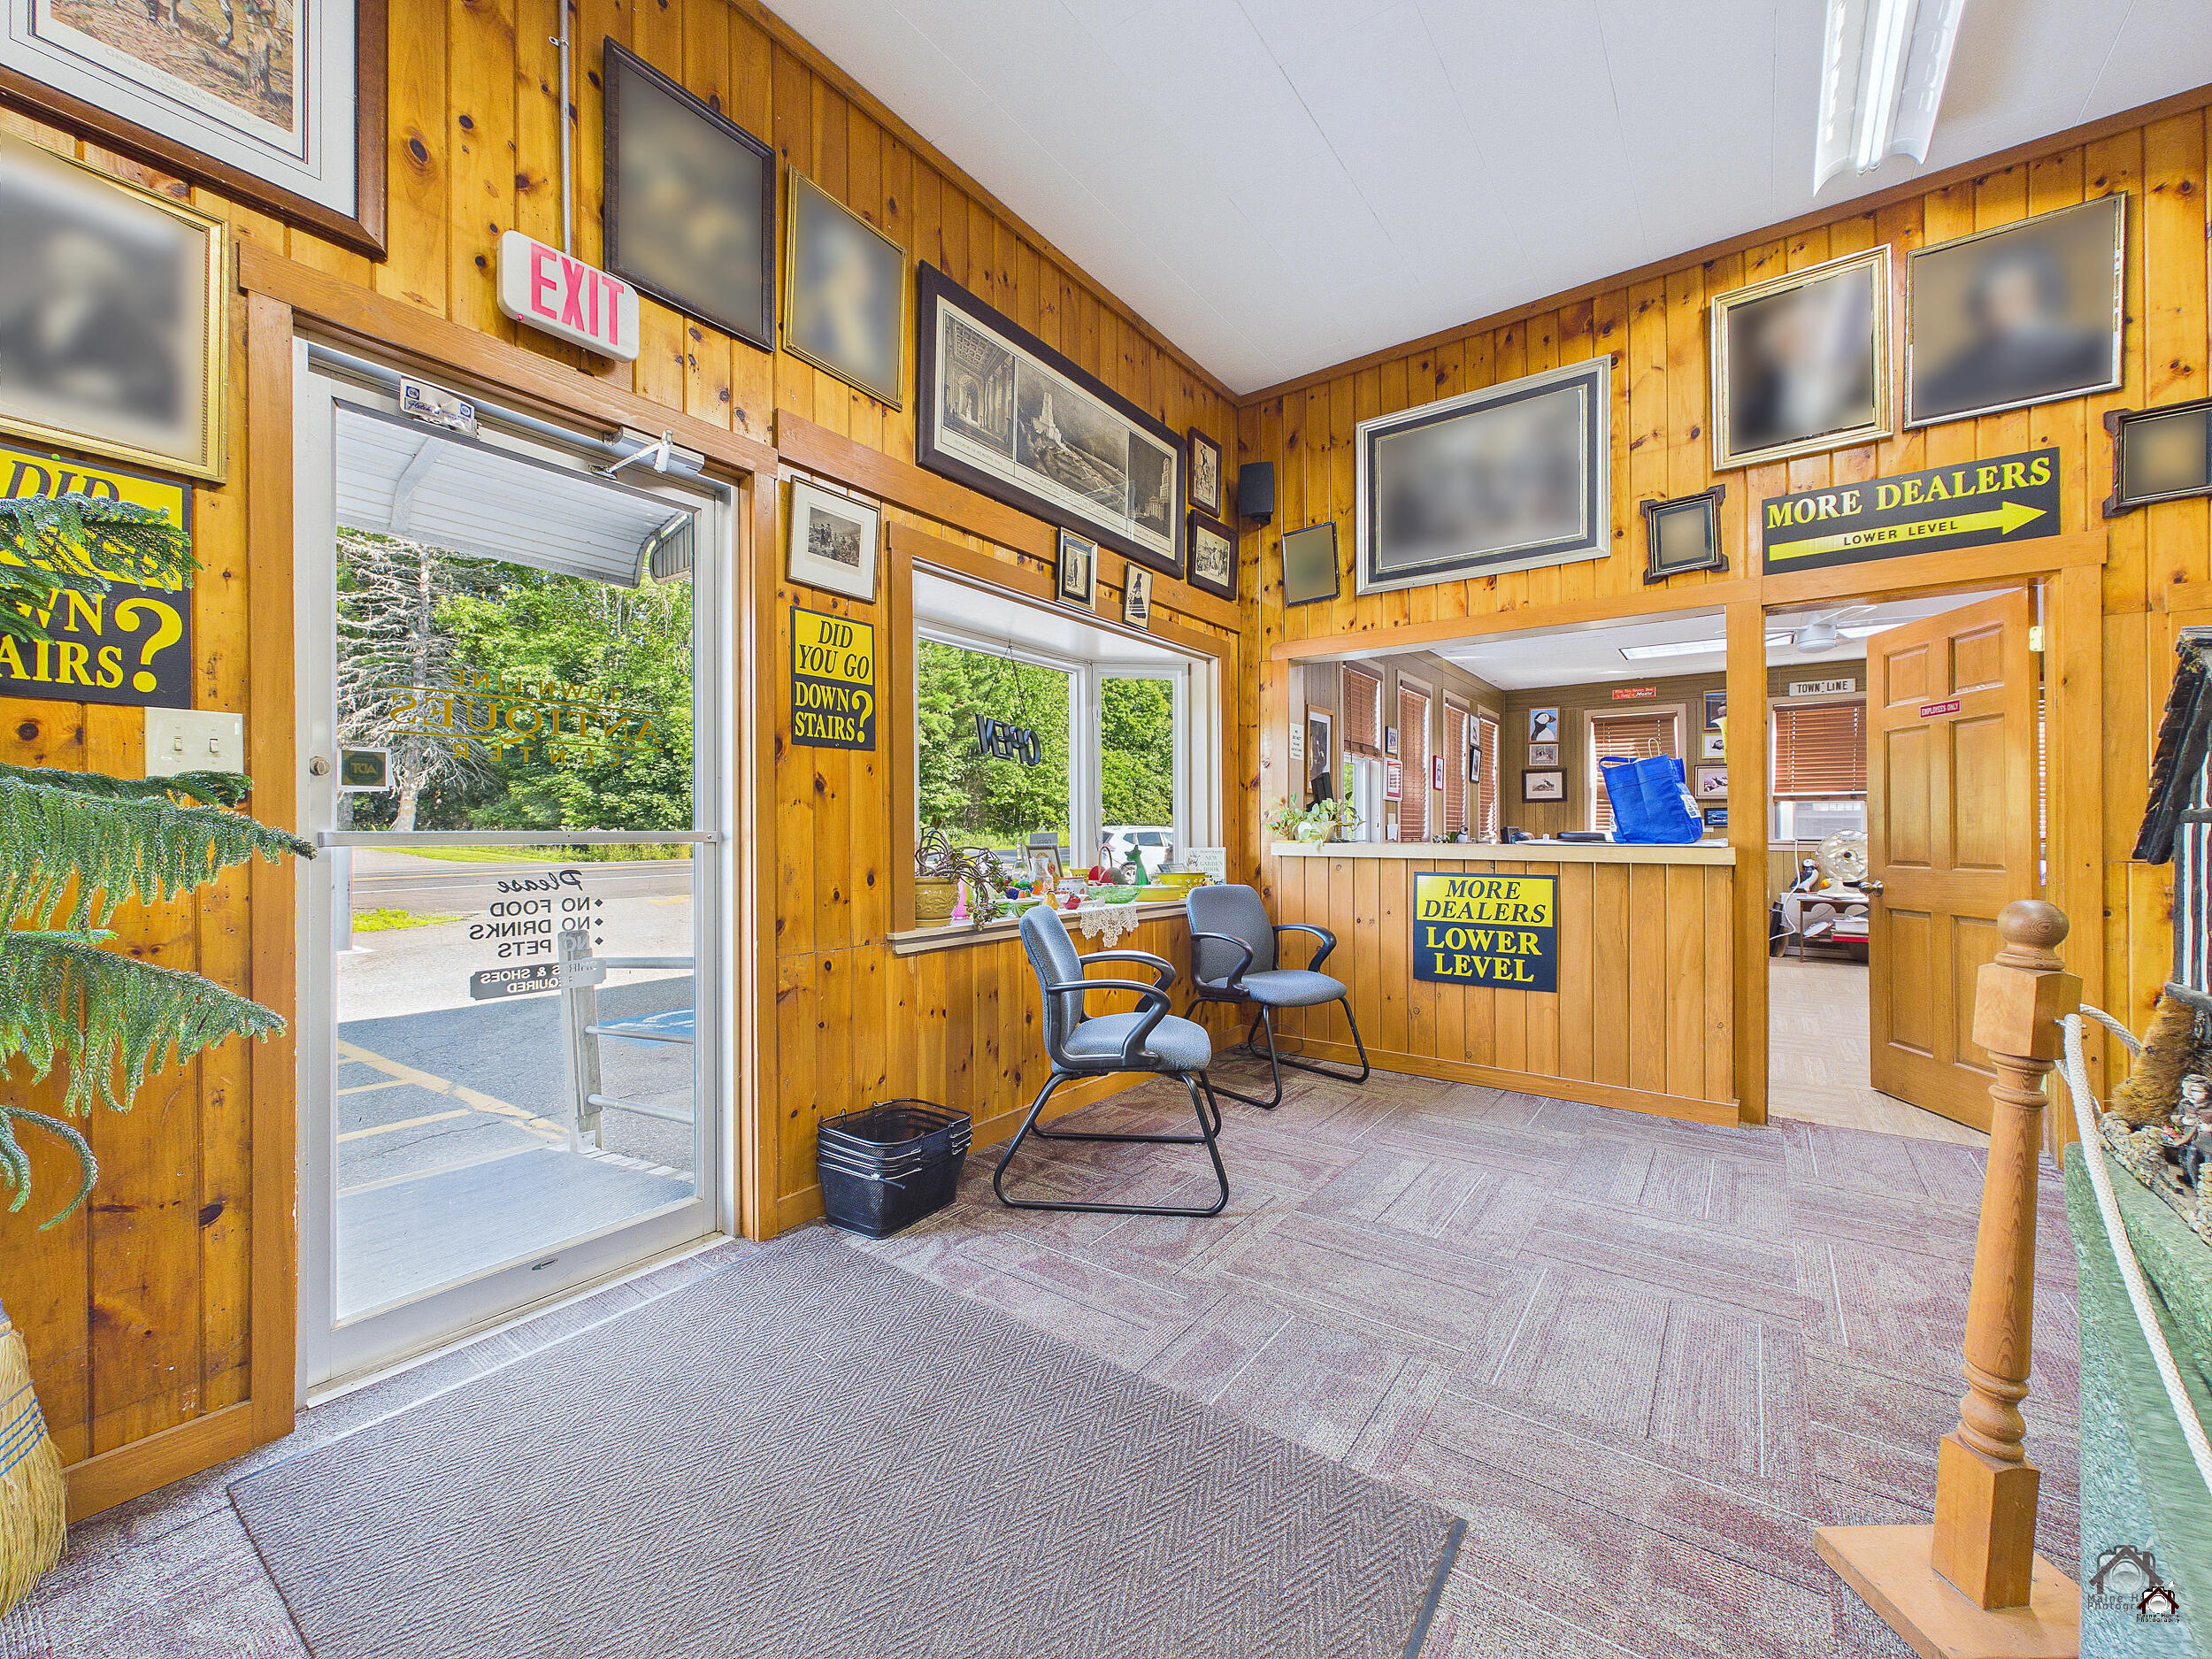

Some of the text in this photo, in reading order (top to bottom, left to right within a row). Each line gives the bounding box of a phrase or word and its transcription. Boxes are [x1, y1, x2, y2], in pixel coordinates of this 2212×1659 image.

[191, 88, 250, 122] WASHINGTON
[530, 242, 625, 346] EXIT
[1766, 456, 2052, 530] MORE DEALERS
[1843, 519, 1958, 546] LOWER LEVEL
[818, 619, 854, 649] DID
[799, 643, 871, 680] YOU GO
[795, 680, 850, 713] DOWN
[1796, 680, 1848, 694] TOWN LINE
[1947, 702, 1959, 711] ONLY
[1445, 879, 1522, 900] MORE
[1422, 899, 1547, 924] DEALERS
[1425, 926, 1543, 956] LOWER
[1433, 952, 1535, 983] LEVEL
